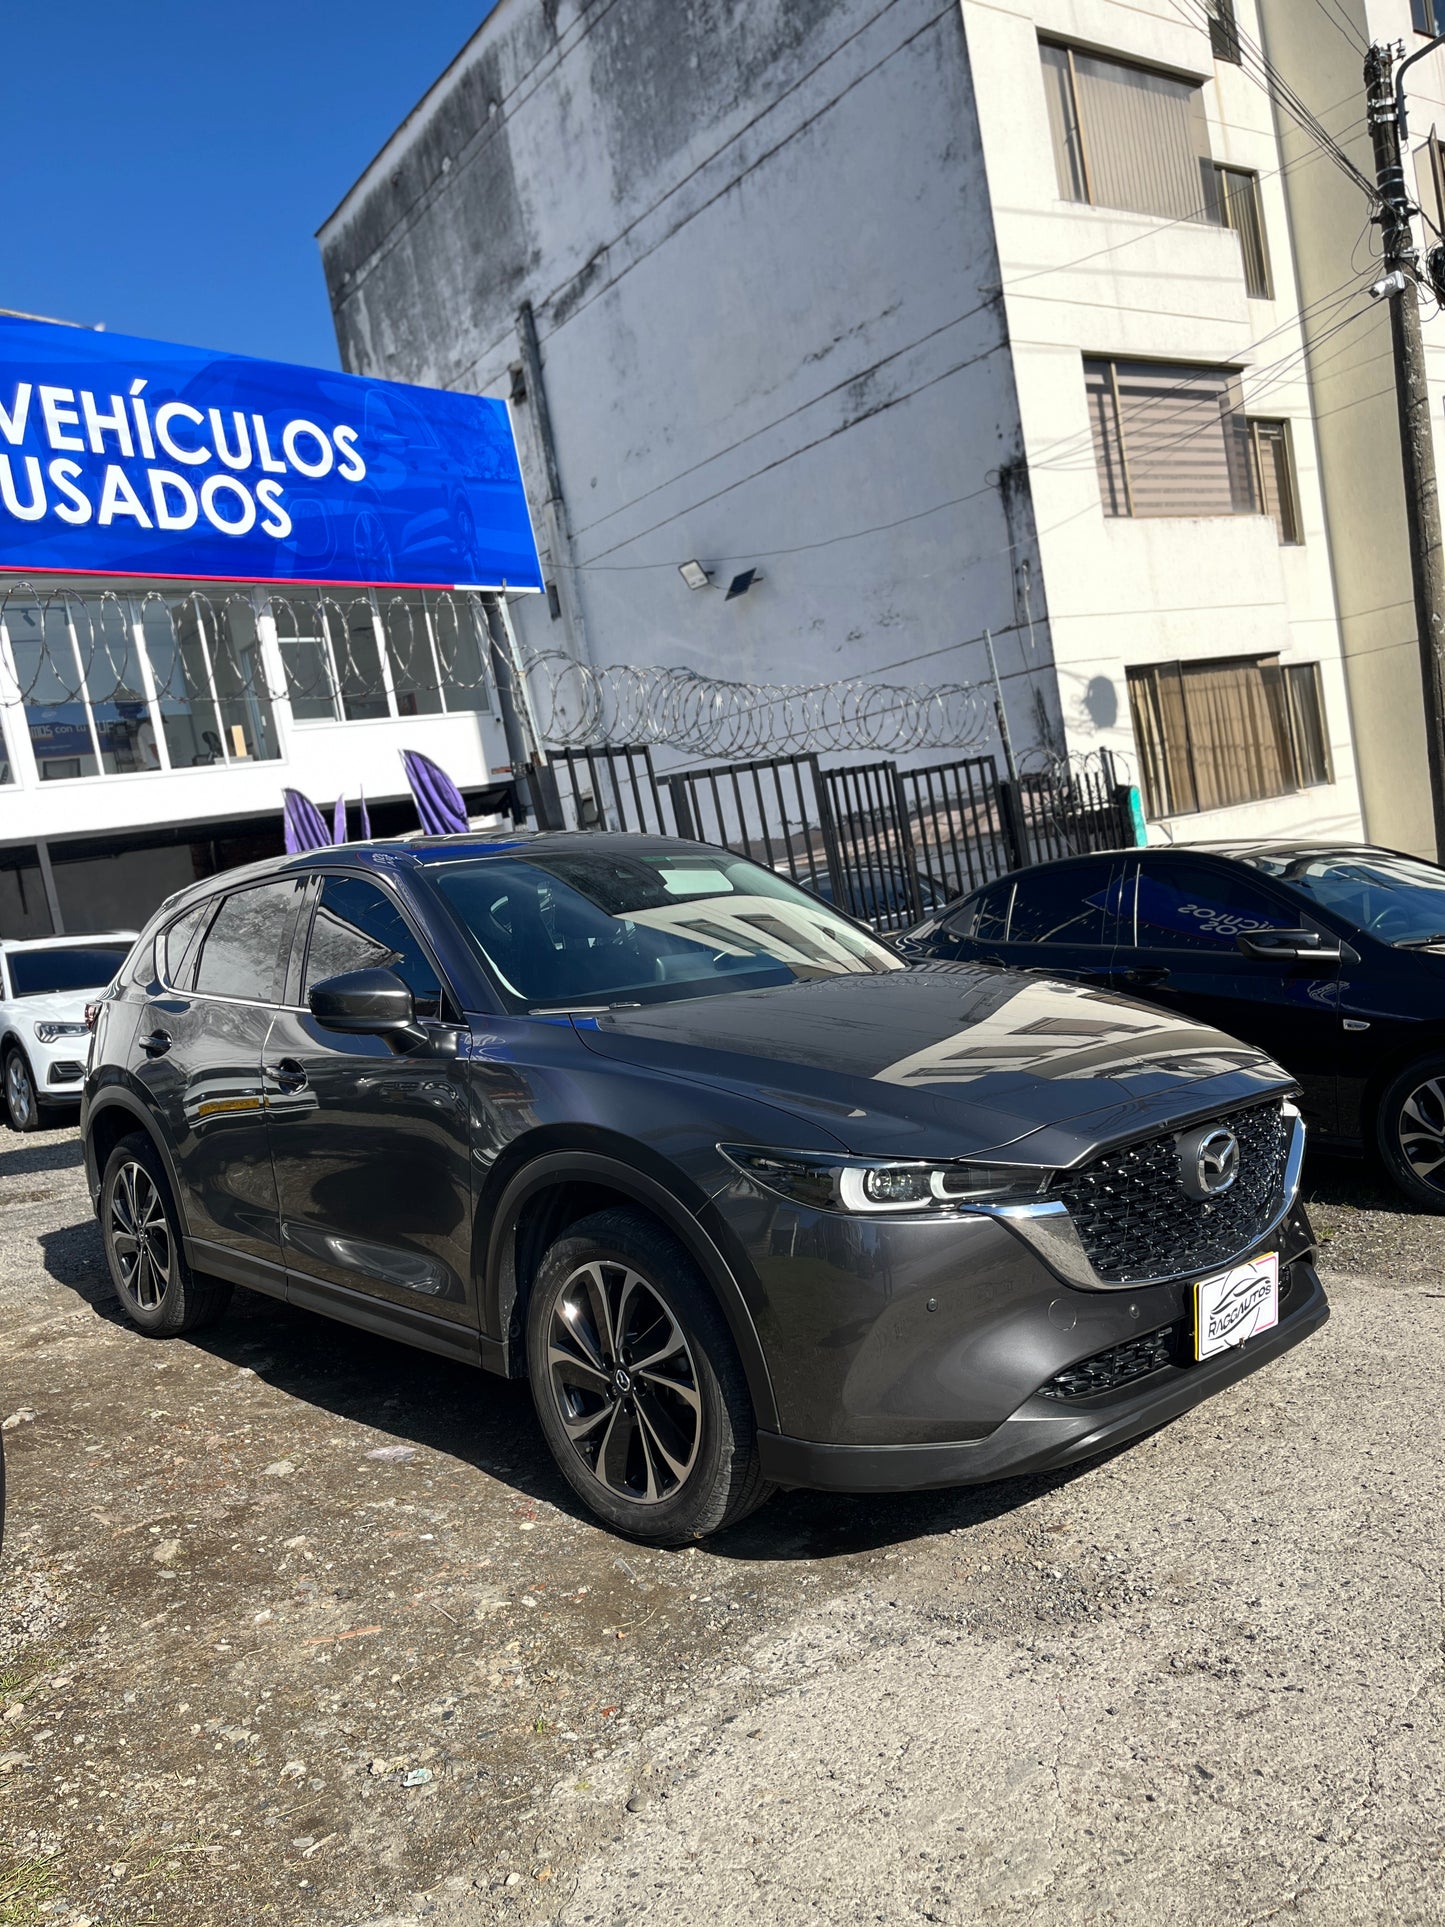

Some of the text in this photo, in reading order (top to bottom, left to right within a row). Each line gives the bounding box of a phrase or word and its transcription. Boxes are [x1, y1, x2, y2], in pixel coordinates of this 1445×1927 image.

[0, 378, 367, 482] VEHÍCULOS
[0, 454, 293, 539] USADOS
[1208, 1284, 1272, 1338] RAGGAUTOS
